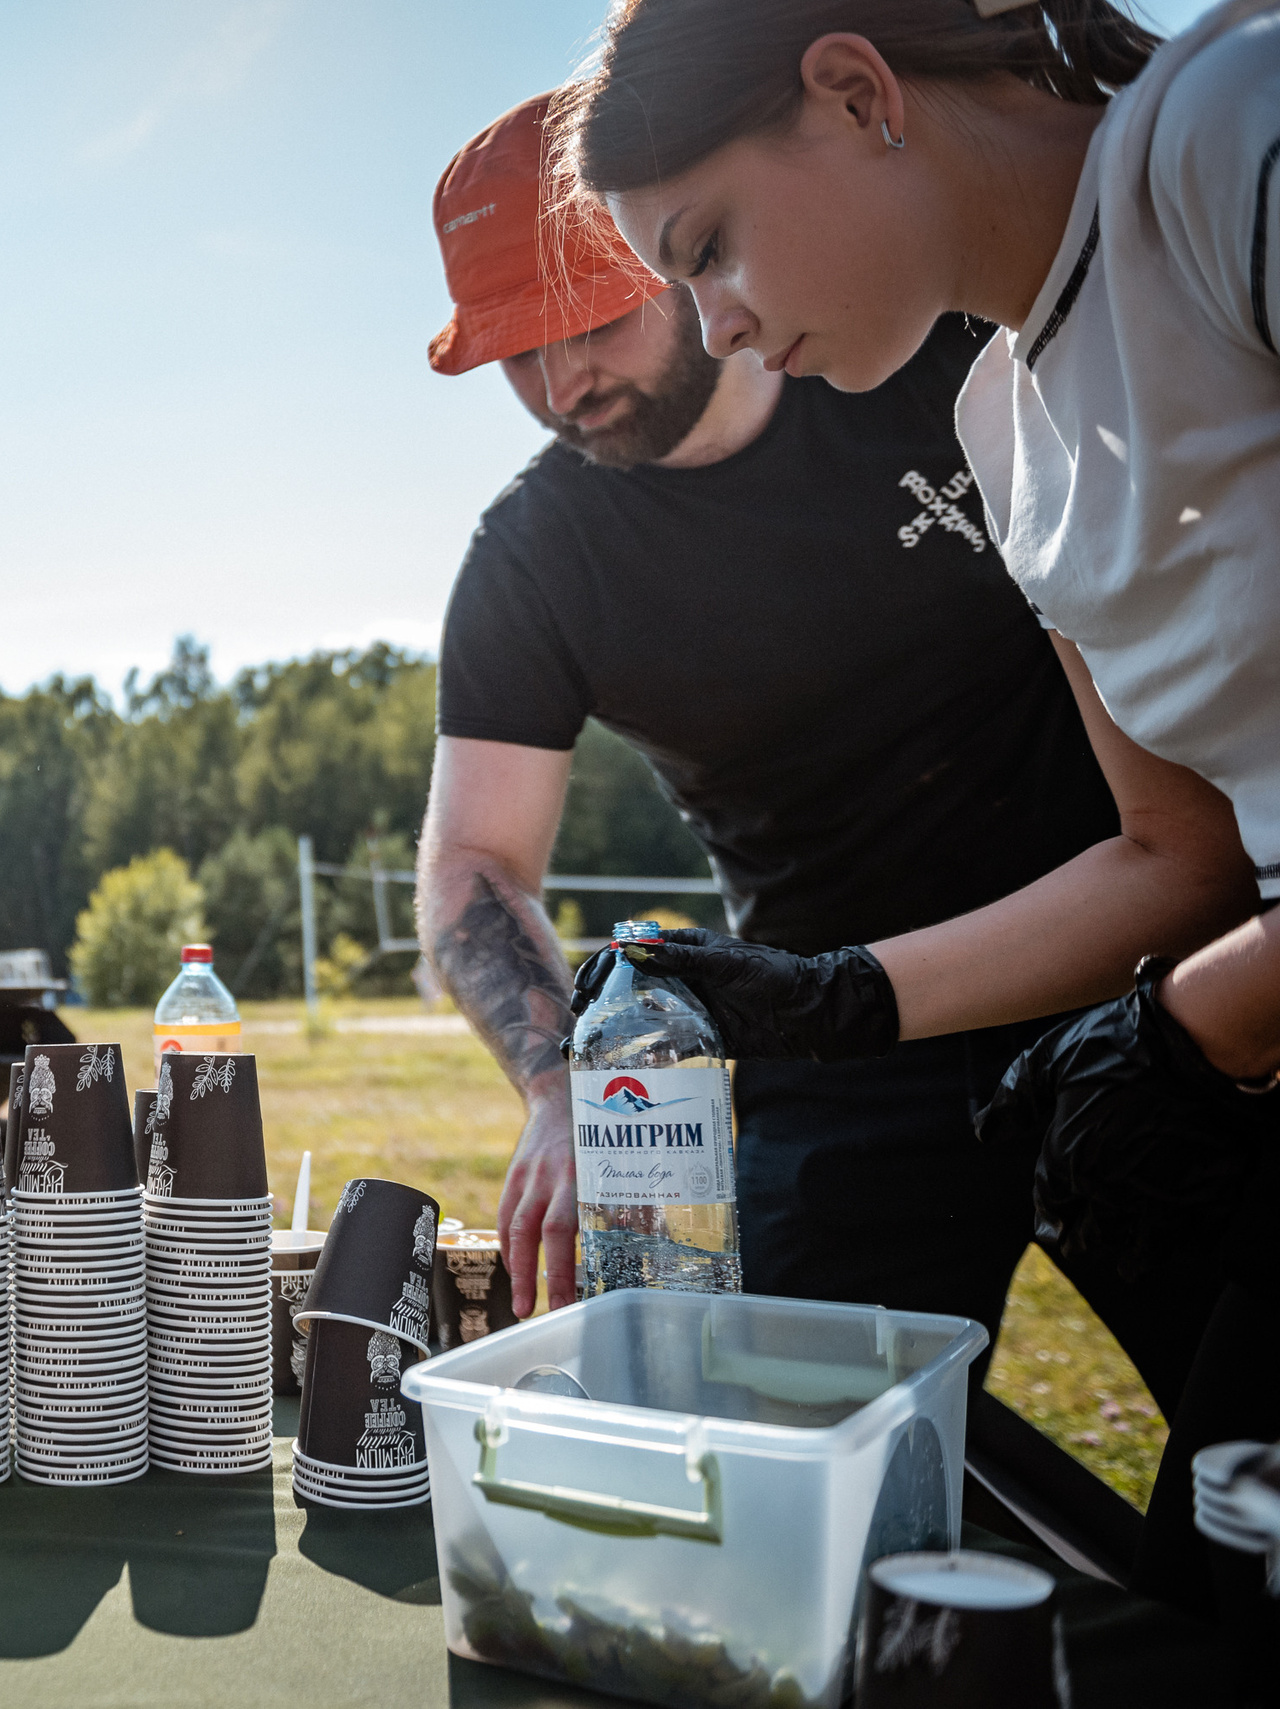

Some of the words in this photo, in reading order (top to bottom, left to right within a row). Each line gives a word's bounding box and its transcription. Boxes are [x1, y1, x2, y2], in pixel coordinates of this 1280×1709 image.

[27, 1128, 47, 1142] TEA
[577, 1122, 704, 1148] ПИЛИГРИМ
[24, 1141, 56, 1156] COFFEE
[19, 1155, 68, 1184] Quality
[691, 1176, 708, 1185] 1100
[370, 1397, 397, 1413] TEA
[364, 1410, 406, 1429] COFFEE
[355, 1428, 416, 1454] Quality
[355, 1445, 416, 1468] PREMIUM
